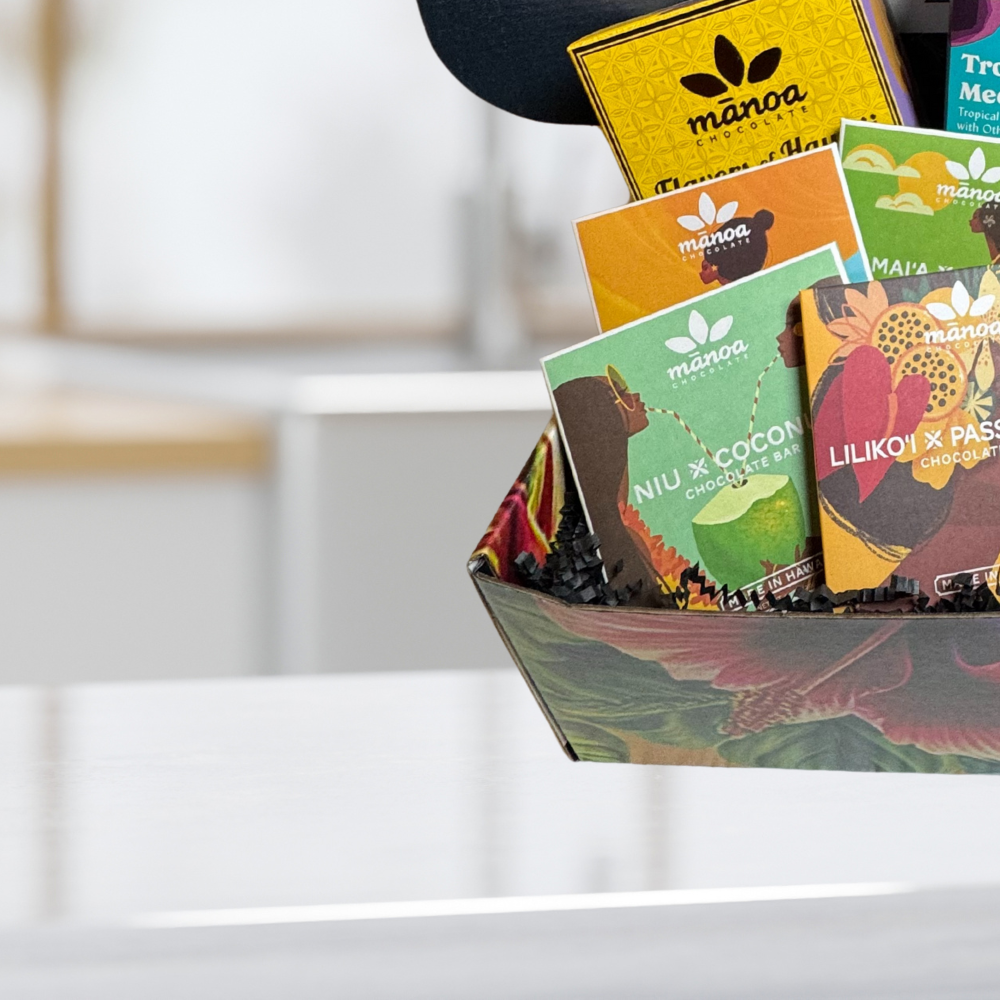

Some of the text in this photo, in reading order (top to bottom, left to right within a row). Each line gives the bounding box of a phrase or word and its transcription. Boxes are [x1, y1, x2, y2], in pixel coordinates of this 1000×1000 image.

[687, 84, 808, 135] mānoa
[696, 106, 809, 147] CHOCOLATE
[958, 107, 999, 122] Tropical
[957, 122, 978, 133] with
[678, 223, 751, 254] mānoa
[682, 238, 750, 261] CHOCOLATE
[667, 339, 749, 380] mānoa
[672, 354, 749, 389] CHOCOLATE
[633, 420, 805, 504] NIU COCON
[686, 444, 800, 500] CHOCOLATE BAR
[768, 577, 782, 589] IN
[786, 559, 822, 581] HAWA
